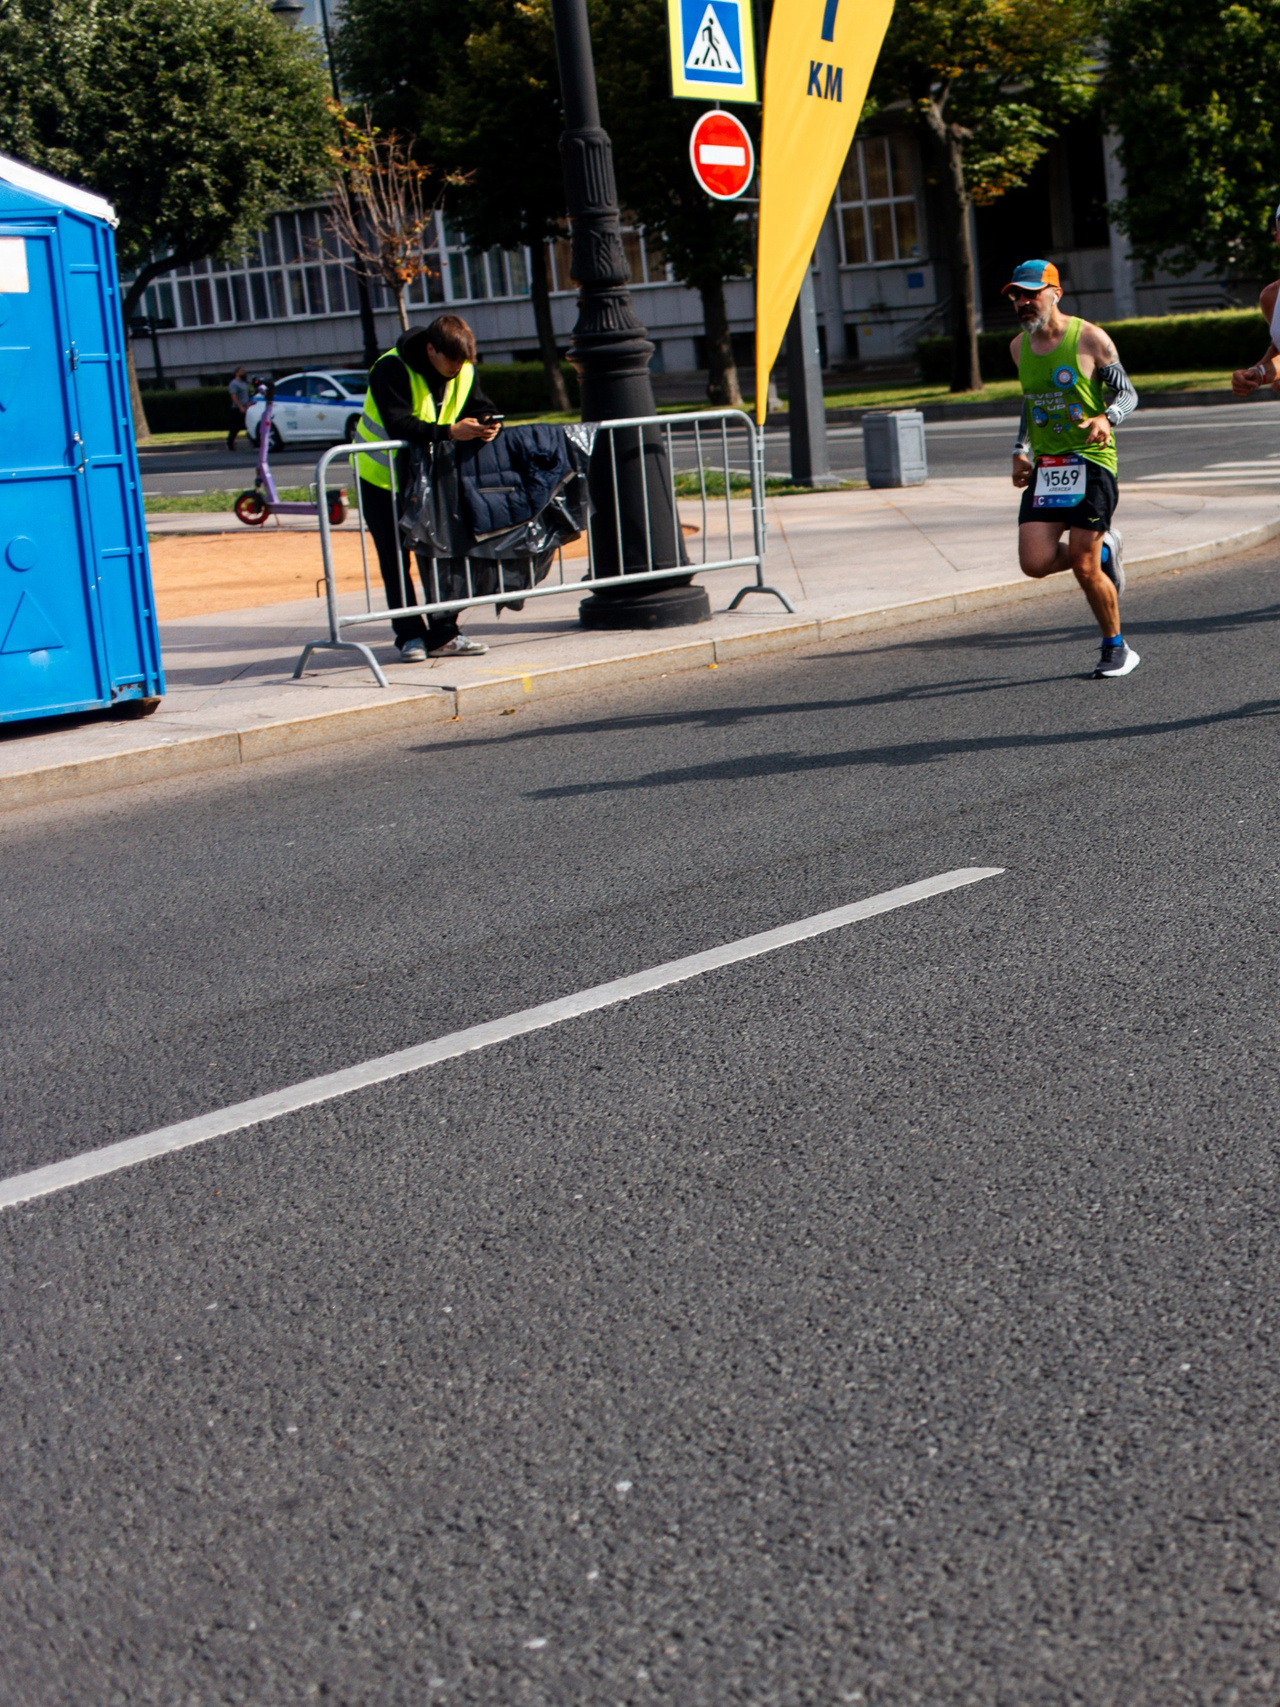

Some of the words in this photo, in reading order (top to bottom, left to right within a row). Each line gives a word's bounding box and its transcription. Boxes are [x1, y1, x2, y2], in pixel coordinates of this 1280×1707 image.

[807, 60, 843, 103] KM
[1043, 469, 1080, 487] 1569
[1038, 496, 1045, 505] C
